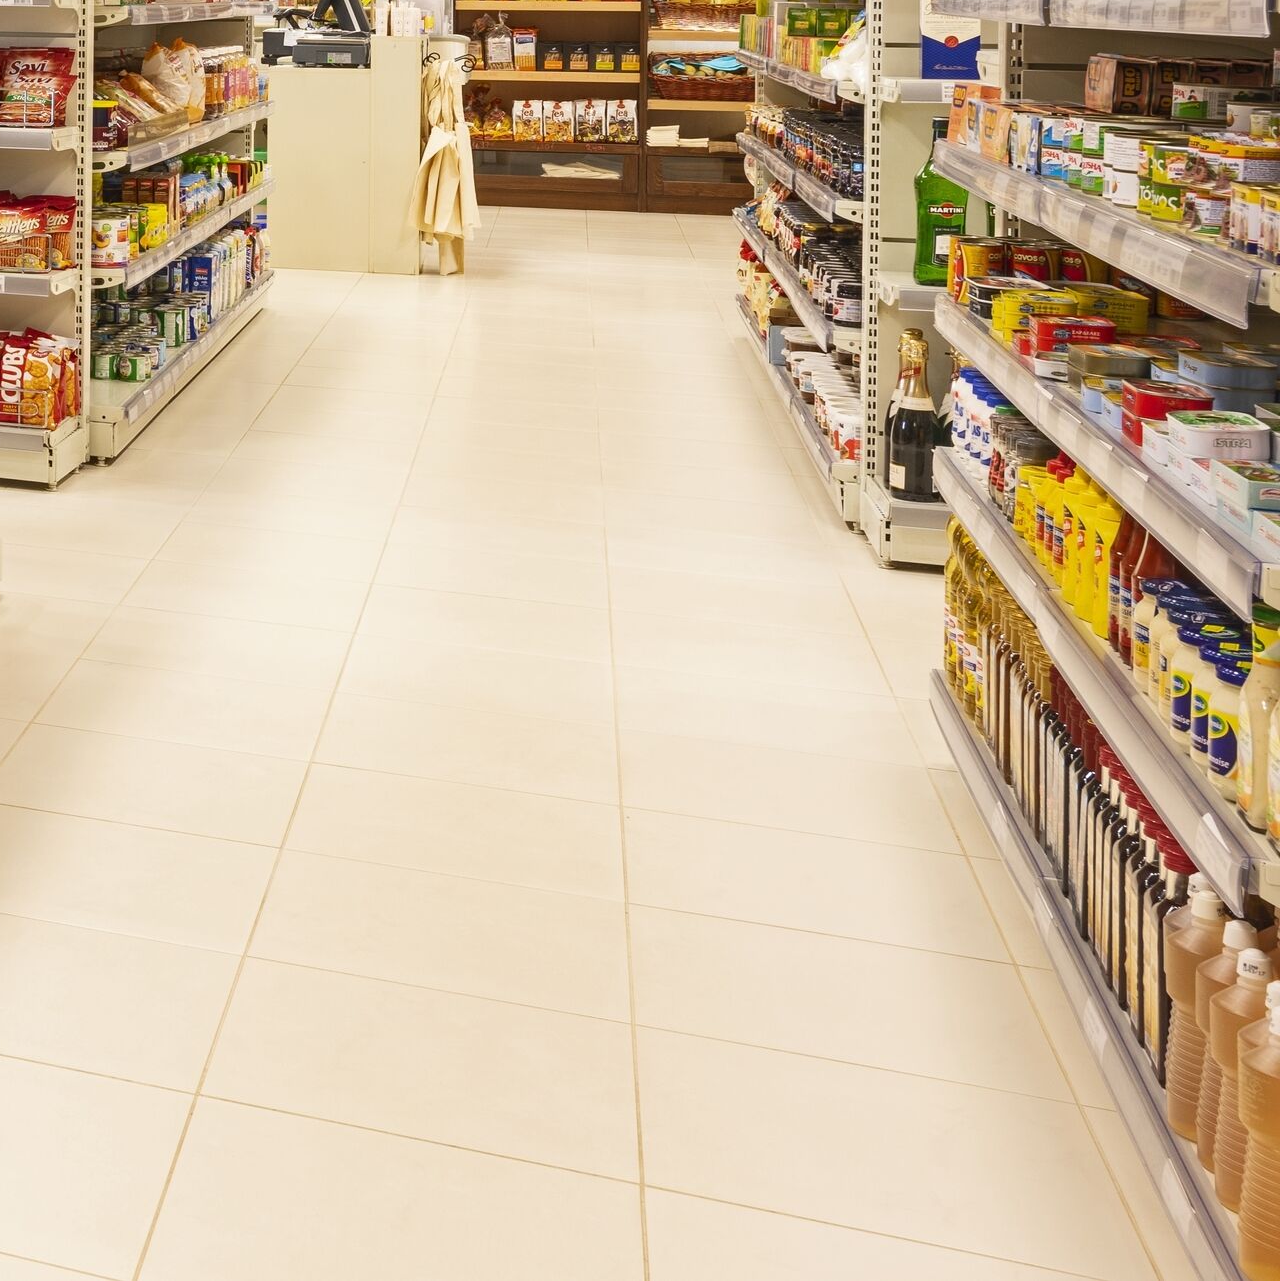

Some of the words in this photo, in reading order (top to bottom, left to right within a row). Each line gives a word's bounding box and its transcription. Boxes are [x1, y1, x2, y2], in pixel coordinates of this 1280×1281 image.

[9, 60, 49, 74] Savi
[929, 206, 964, 214] MARTINI
[1213, 438, 1252, 448] ISTRA
